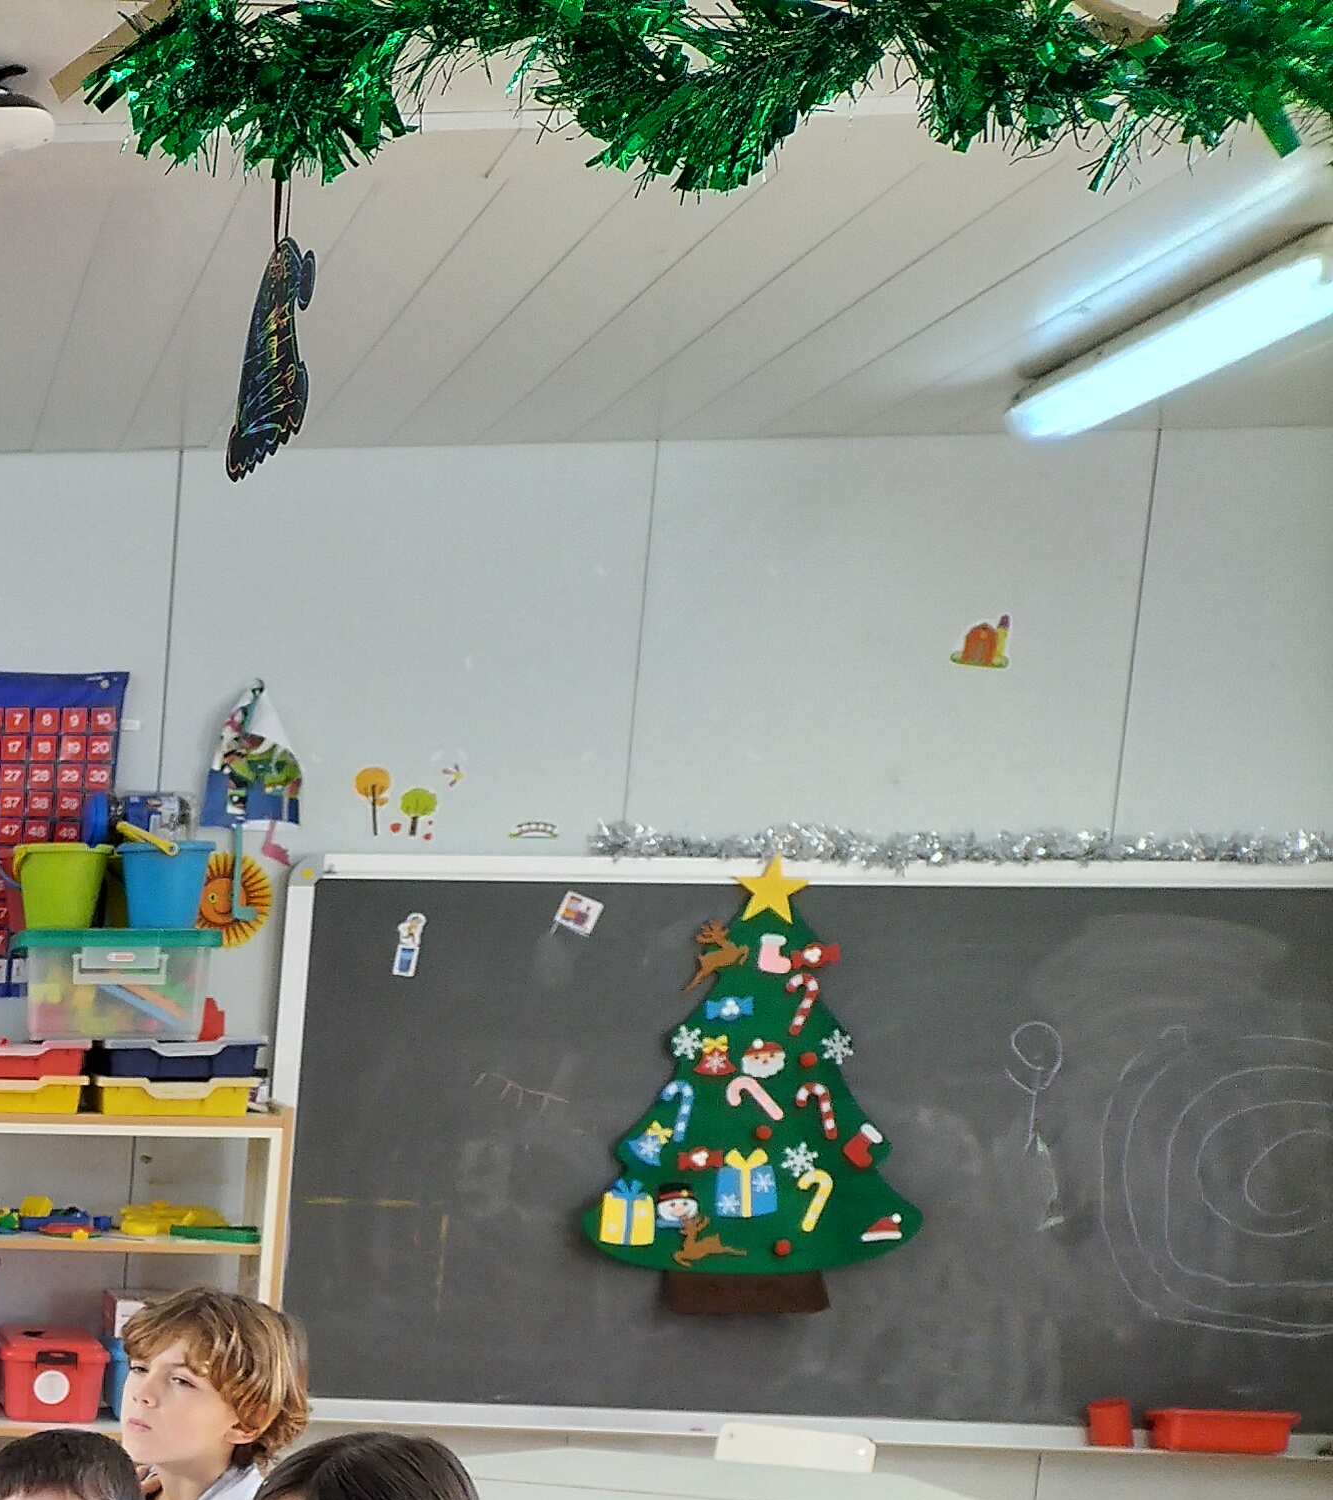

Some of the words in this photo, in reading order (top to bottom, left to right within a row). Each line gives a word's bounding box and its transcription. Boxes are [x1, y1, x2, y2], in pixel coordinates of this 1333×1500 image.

[96, 712, 111, 725] 10
[7, 740, 22, 753] 17
[66, 741, 81, 754] 19
[91, 741, 110, 754] 20
[3, 769, 22, 782] 27
[32, 769, 50, 782] 28
[61, 769, 80, 782] 29
[89, 769, 108, 783] 30
[4, 796, 21, 809] 37
[31, 797, 49, 810] 38
[61, 797, 80, 810] 39
[1, 824, 19, 837] 47
[28, 825, 47, 838] 48
[59, 827, 77, 839] 49
